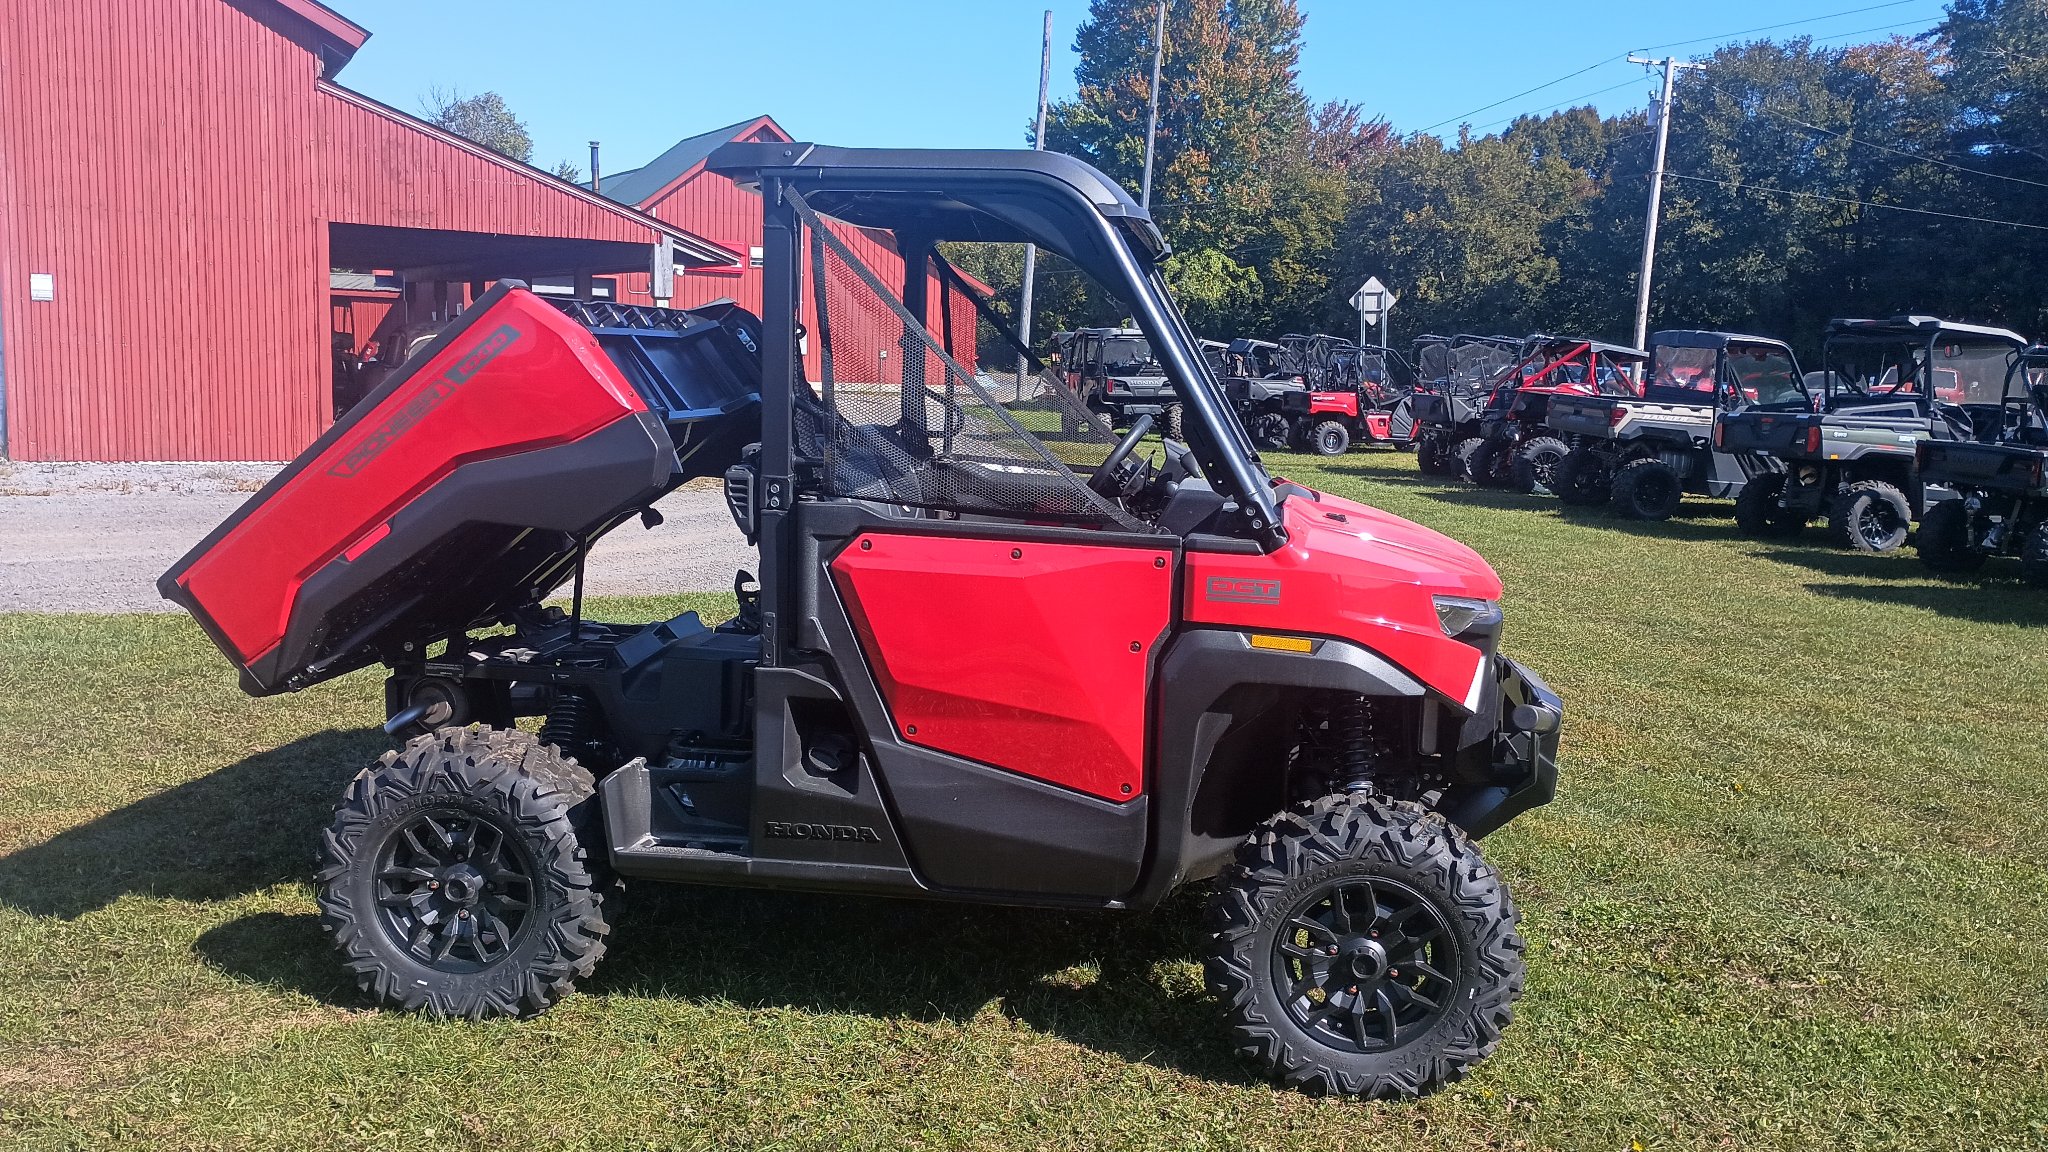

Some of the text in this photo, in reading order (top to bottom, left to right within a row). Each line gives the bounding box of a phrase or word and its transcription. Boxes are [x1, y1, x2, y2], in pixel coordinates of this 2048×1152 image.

[342, 379, 452, 476] PIONEER
[1209, 579, 1277, 595] DCT
[766, 821, 881, 841] HONDA
